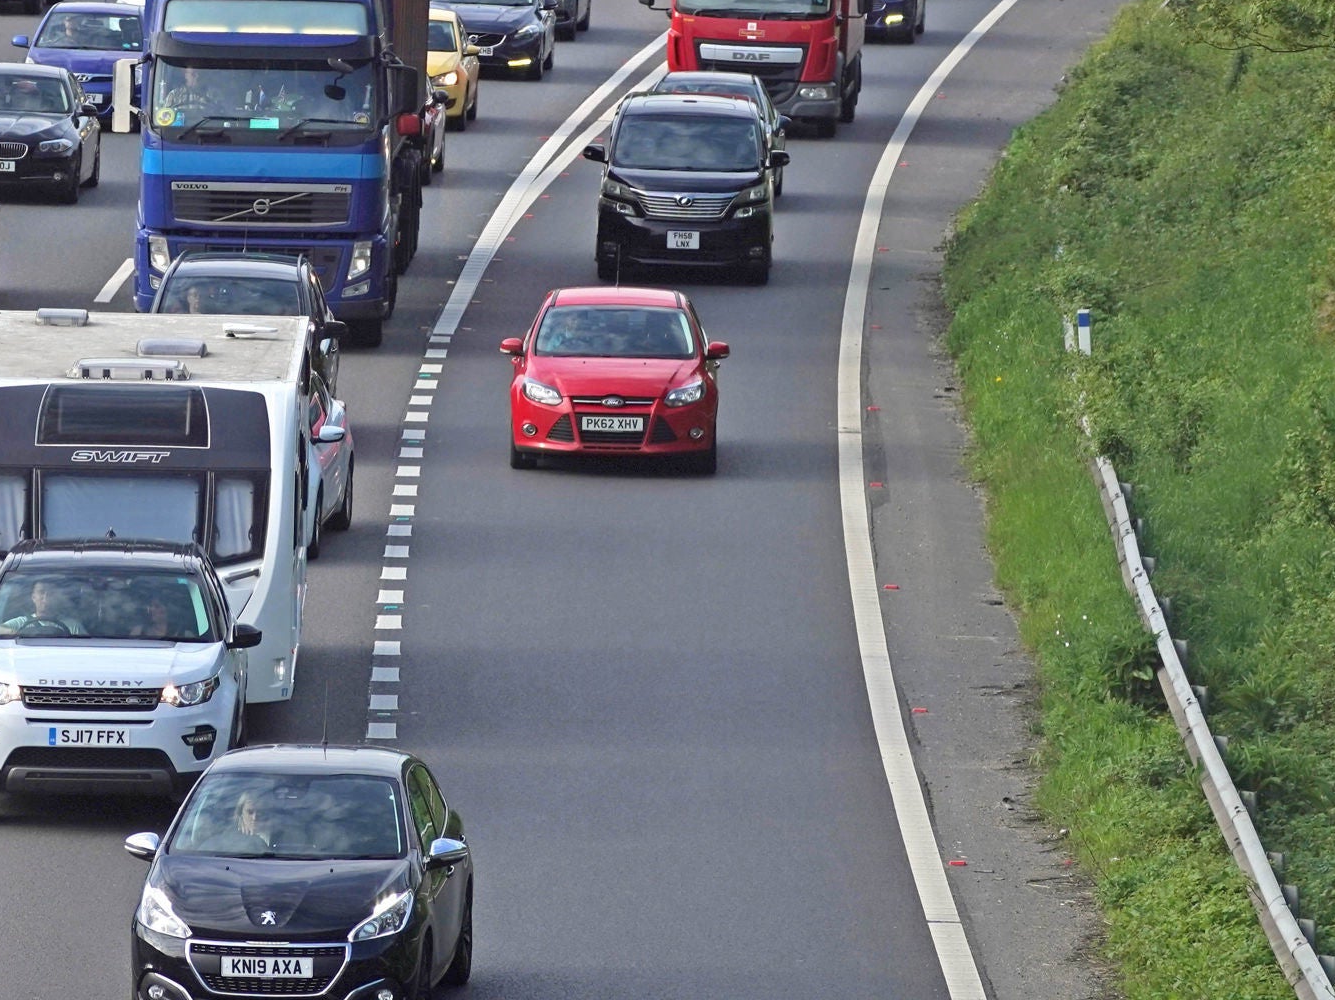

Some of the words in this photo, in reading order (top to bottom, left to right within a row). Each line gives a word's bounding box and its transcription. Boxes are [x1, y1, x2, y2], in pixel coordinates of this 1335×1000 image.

[732, 52, 769, 61] DAF
[673, 232, 693, 240] FH58
[586, 418, 615, 429] PK62
[617, 418, 639, 429] XHV
[71, 450, 171, 463] SWIFT
[38, 679, 144, 687] DISCOVERY
[61, 729, 93, 743] SJ17
[97, 730, 125, 744] FFX
[231, 958, 267, 974] KN19
[271, 959, 303, 975] AXA
